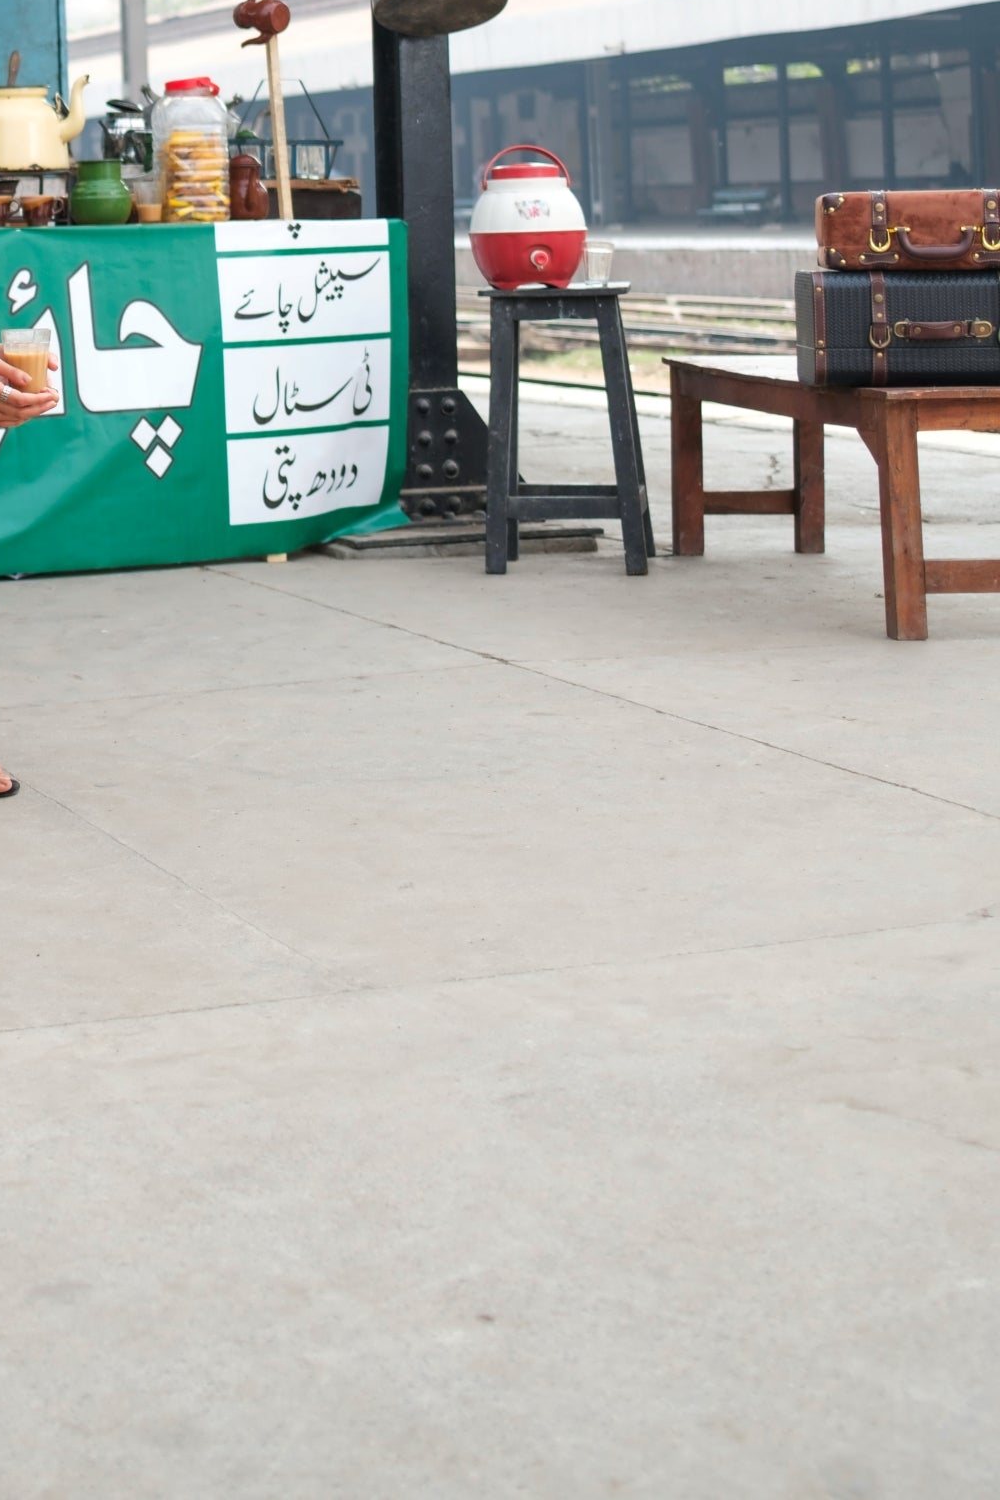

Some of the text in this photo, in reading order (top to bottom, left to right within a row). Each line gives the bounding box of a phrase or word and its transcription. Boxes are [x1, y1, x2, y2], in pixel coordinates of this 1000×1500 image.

[233, 256, 381, 334] سپیشل چائے
[252, 346, 373, 425] ٹی سٹال
[262, 444, 359, 511] دودھ پتی
